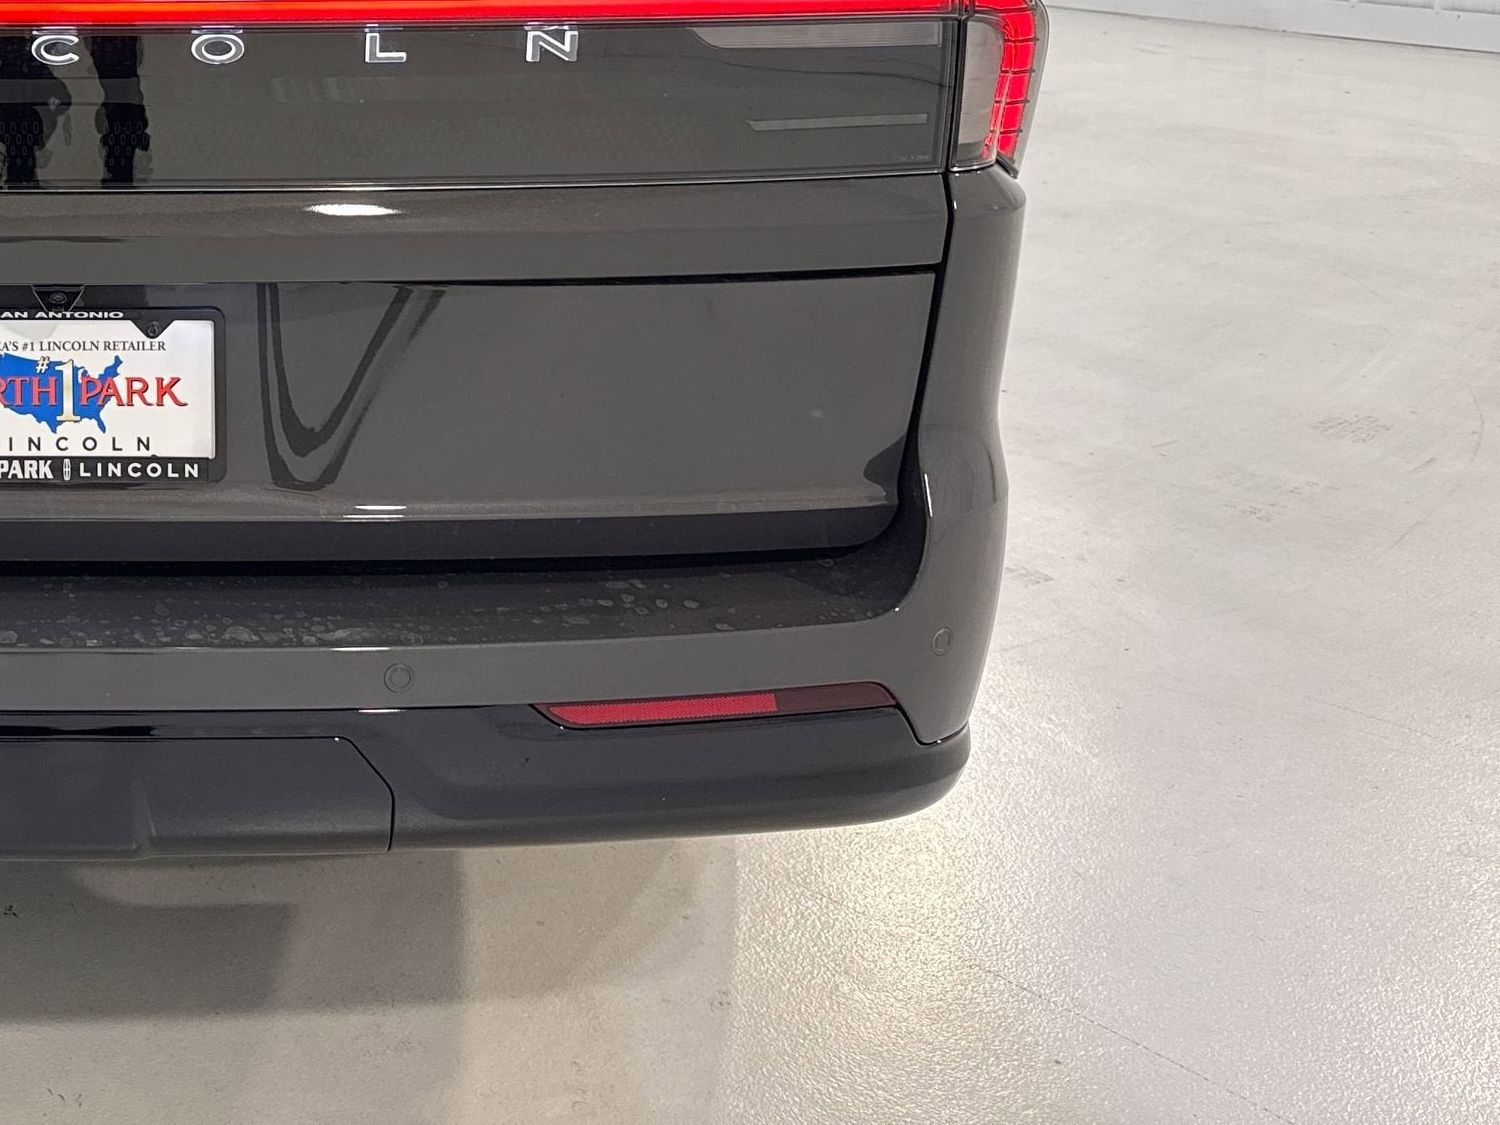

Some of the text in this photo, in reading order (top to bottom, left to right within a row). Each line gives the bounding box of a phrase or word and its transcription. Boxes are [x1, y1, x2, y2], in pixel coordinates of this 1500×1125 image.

[34, 310, 125, 319] ANTONIO
[21, 341, 35, 352] #1
[38, 340, 100, 353] LINCOLN
[103, 340, 167, 353] RETAILER
[79, 376, 188, 408] PARK
[79, 461, 200, 479] LINCOLN
